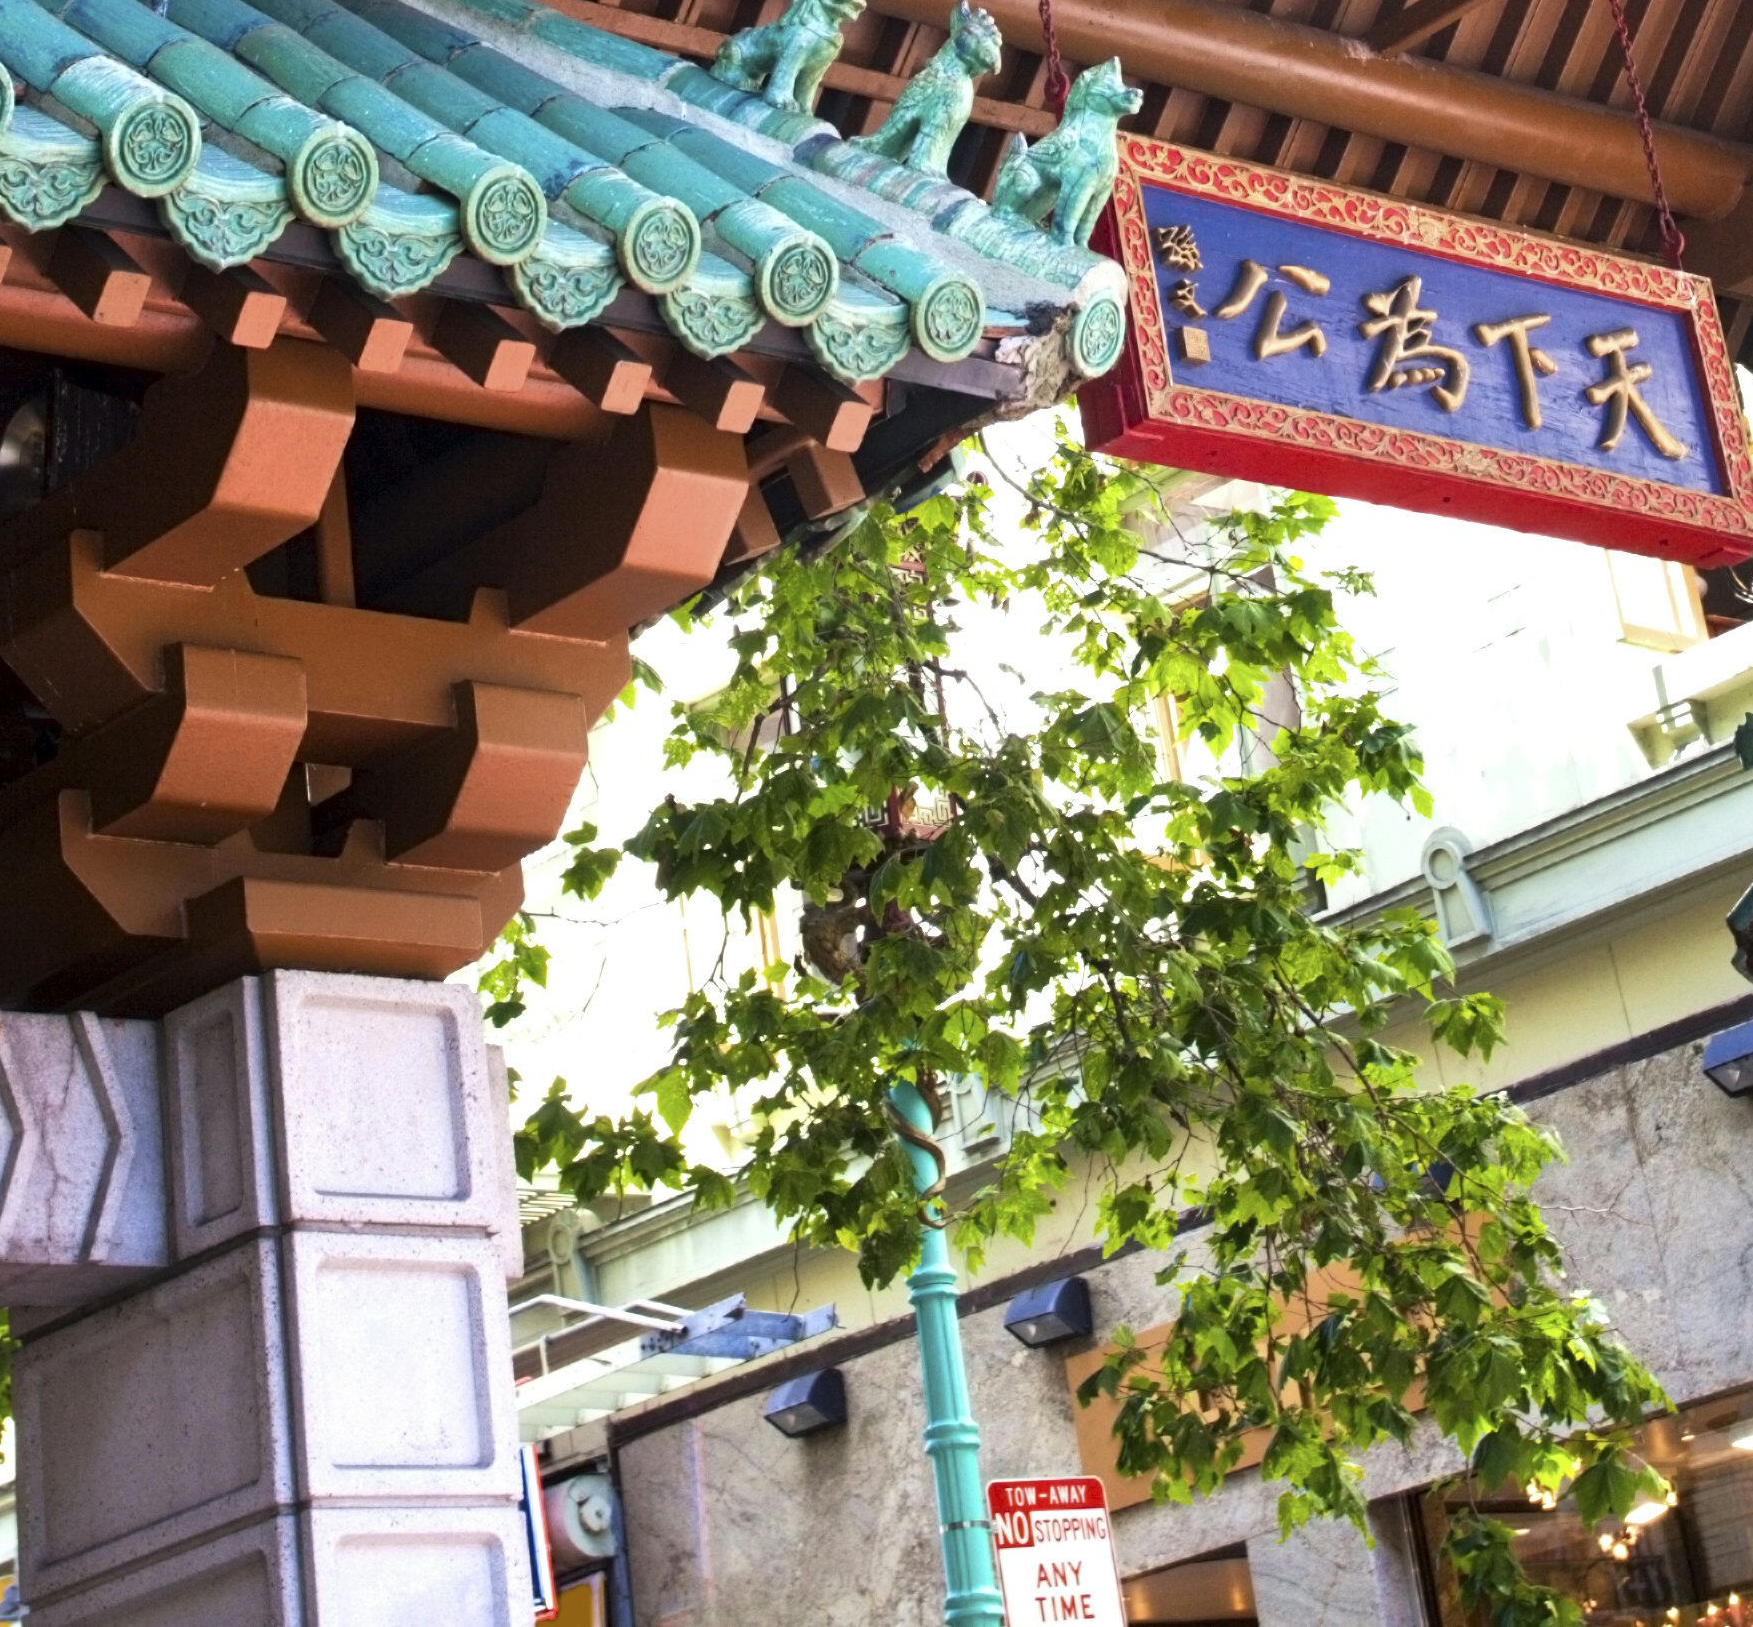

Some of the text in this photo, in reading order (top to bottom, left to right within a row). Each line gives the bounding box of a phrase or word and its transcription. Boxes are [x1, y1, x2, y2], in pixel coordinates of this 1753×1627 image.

[1216, 258, 1688, 461] 天下為公
[1004, 1484, 1087, 1507] TOW-AWAY
[995, 1510, 1107, 1546] NO STOPPING
[1036, 1560, 1083, 1589] ANY
[1034, 1593, 1096, 1623] TIME
